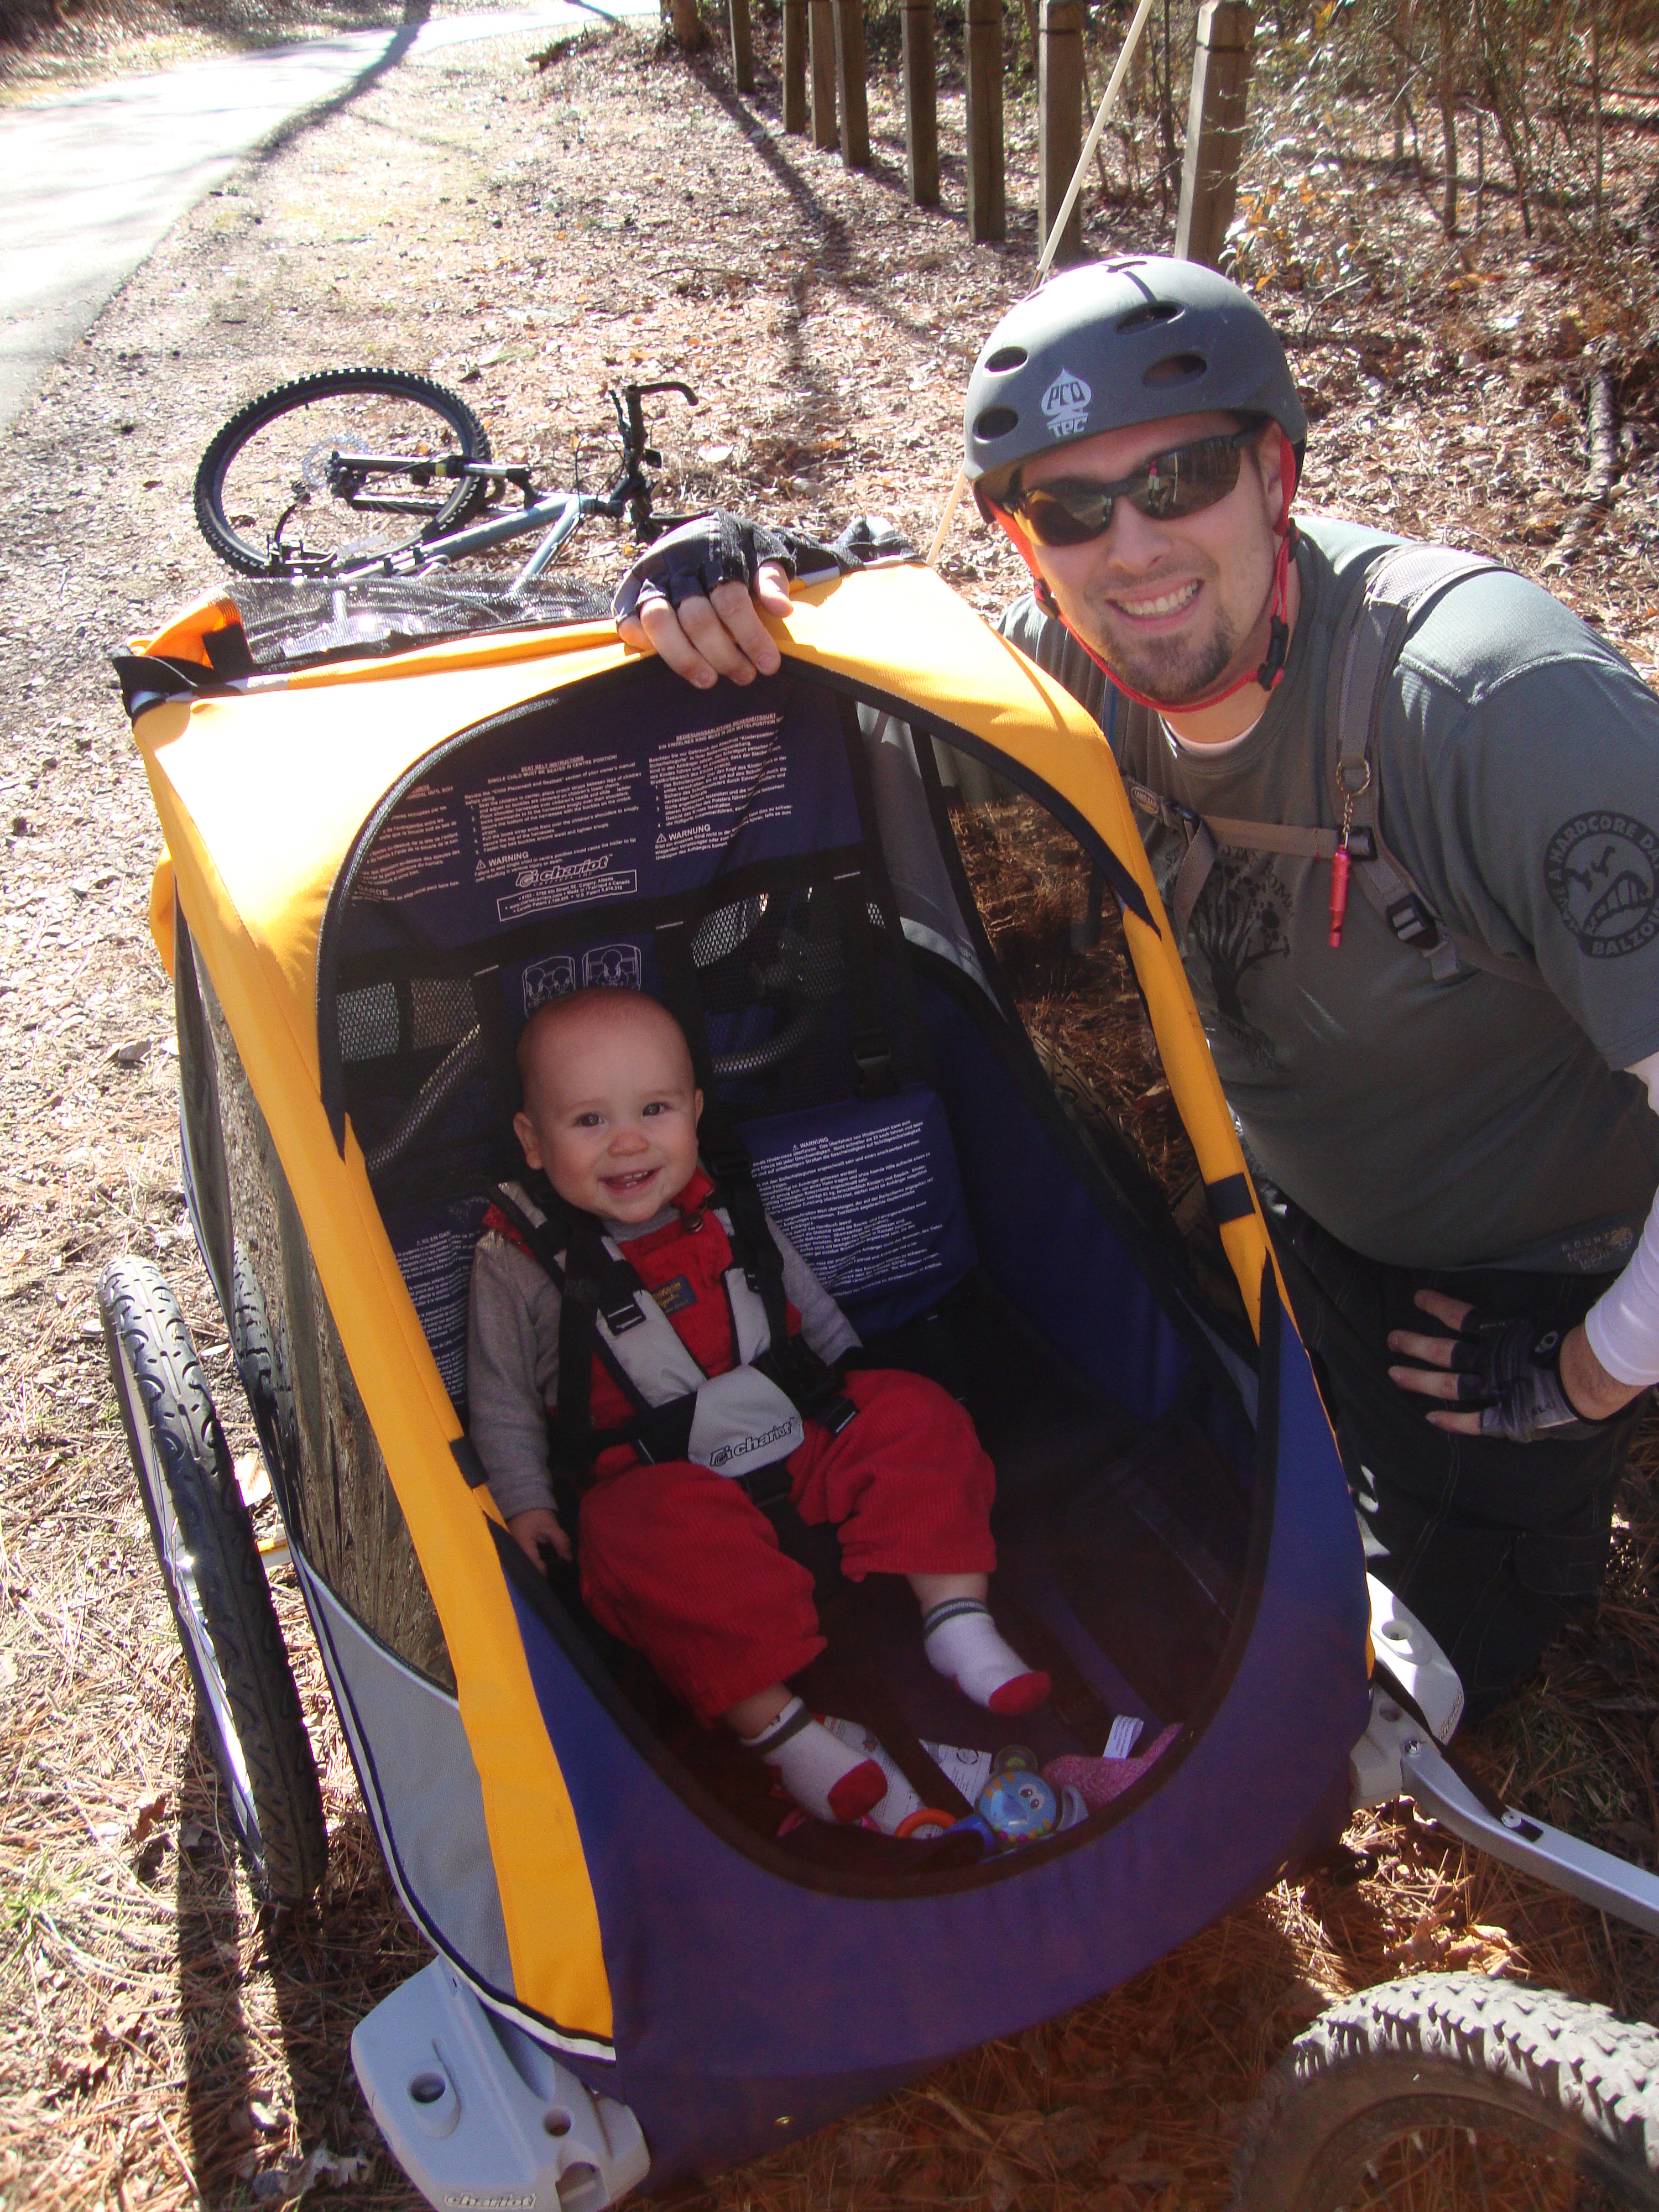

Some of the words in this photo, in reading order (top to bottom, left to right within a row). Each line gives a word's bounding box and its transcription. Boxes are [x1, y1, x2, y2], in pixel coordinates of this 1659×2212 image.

[669, 824, 710, 840] WARNUNG
[1549, 815, 1637, 863] HARDCORE
[488, 852, 529, 865] WARNING
[540, 855, 609, 882] chariot
[734, 1420, 792, 1456] chariot
